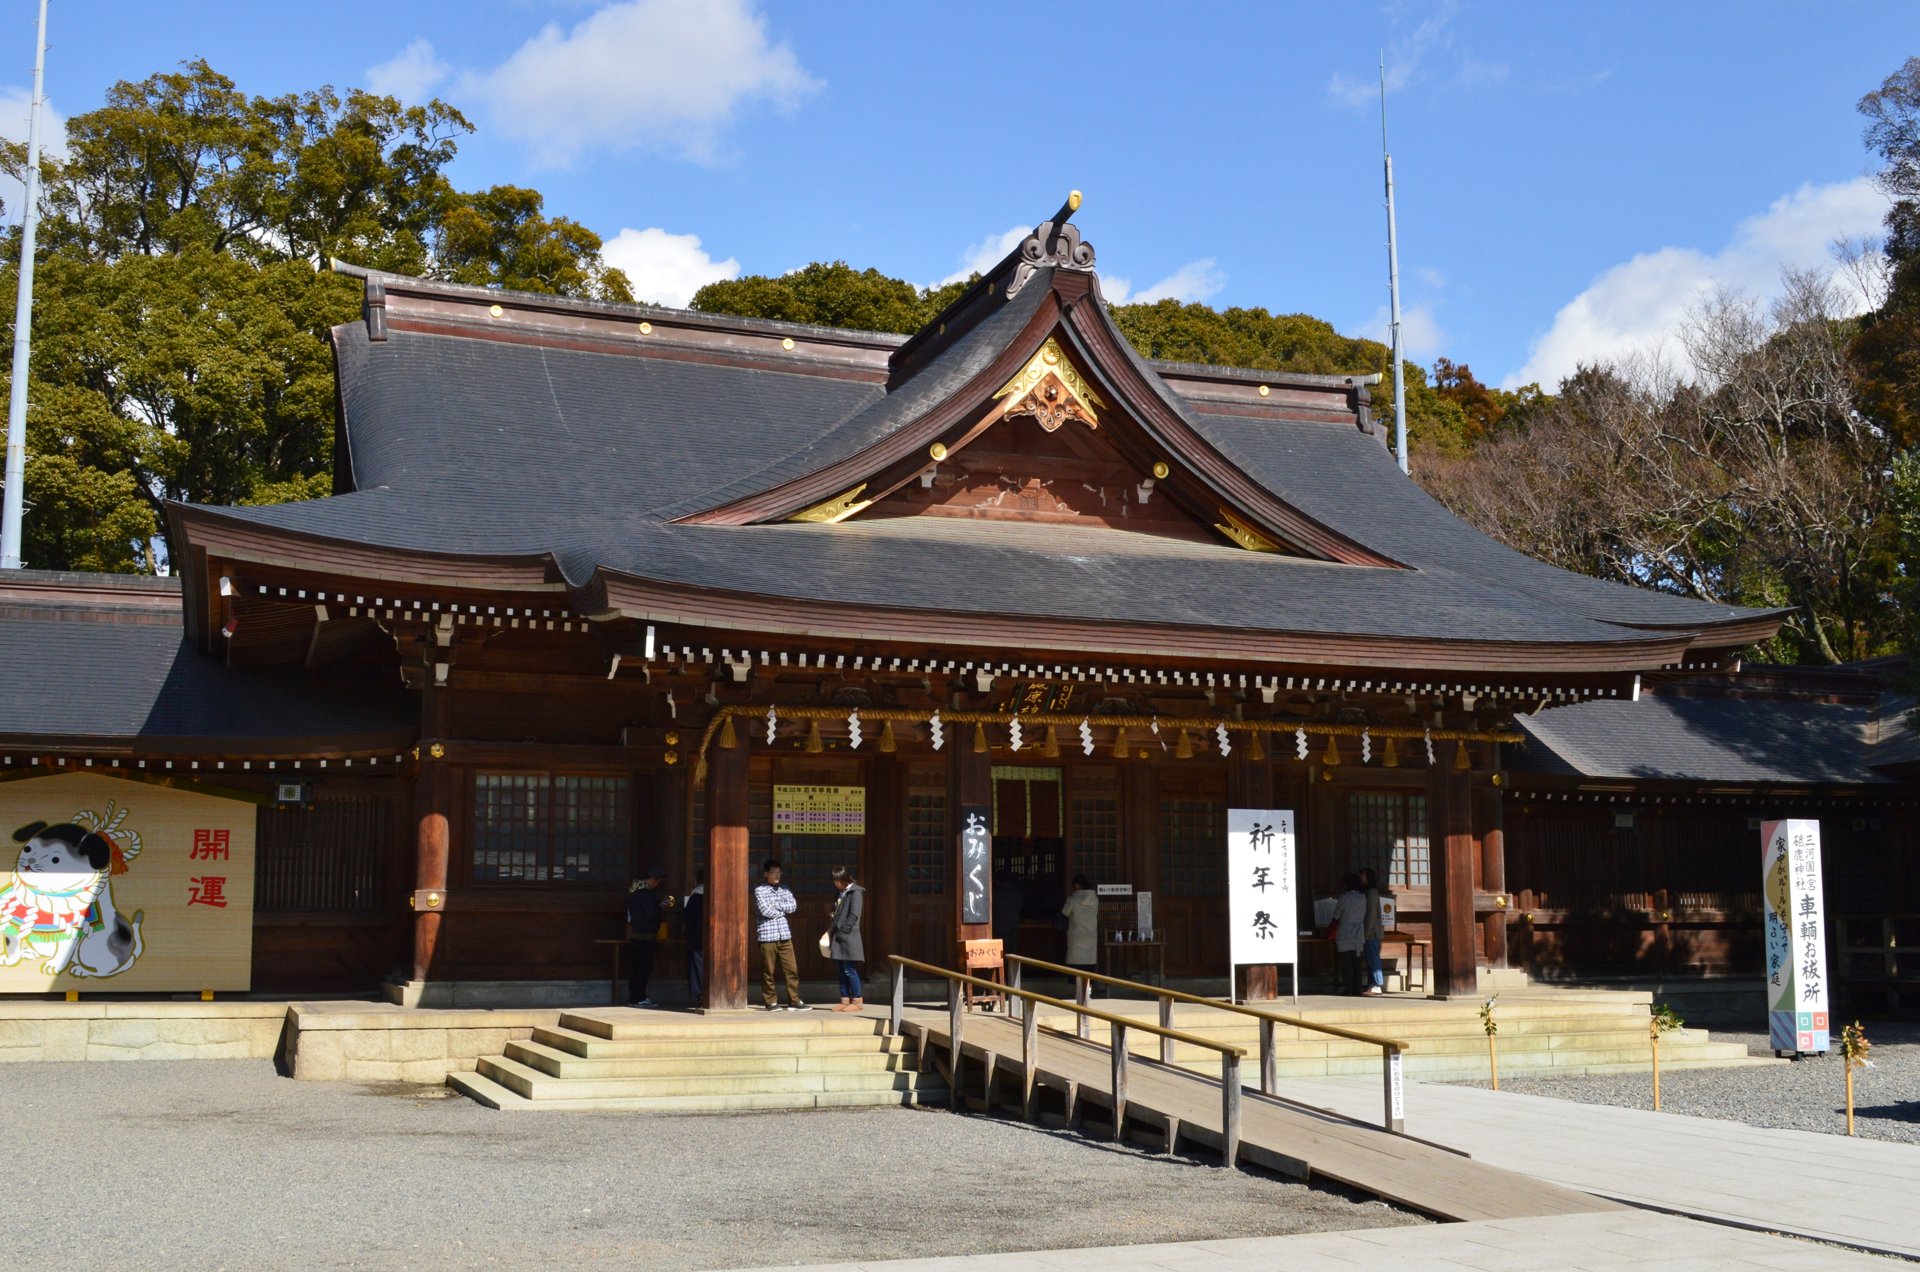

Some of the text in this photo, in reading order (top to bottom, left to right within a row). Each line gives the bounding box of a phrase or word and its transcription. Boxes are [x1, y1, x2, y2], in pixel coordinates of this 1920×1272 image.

[187, 828, 230, 908] 開運
[966, 812, 987, 915] おみくじ
[1249, 822, 1279, 940] 祈年祭
[1792, 834, 1806, 892] 砥鹿神社
[969, 948, 997, 957] おみくじ
[1769, 911, 1782, 987] 明るい家庭
